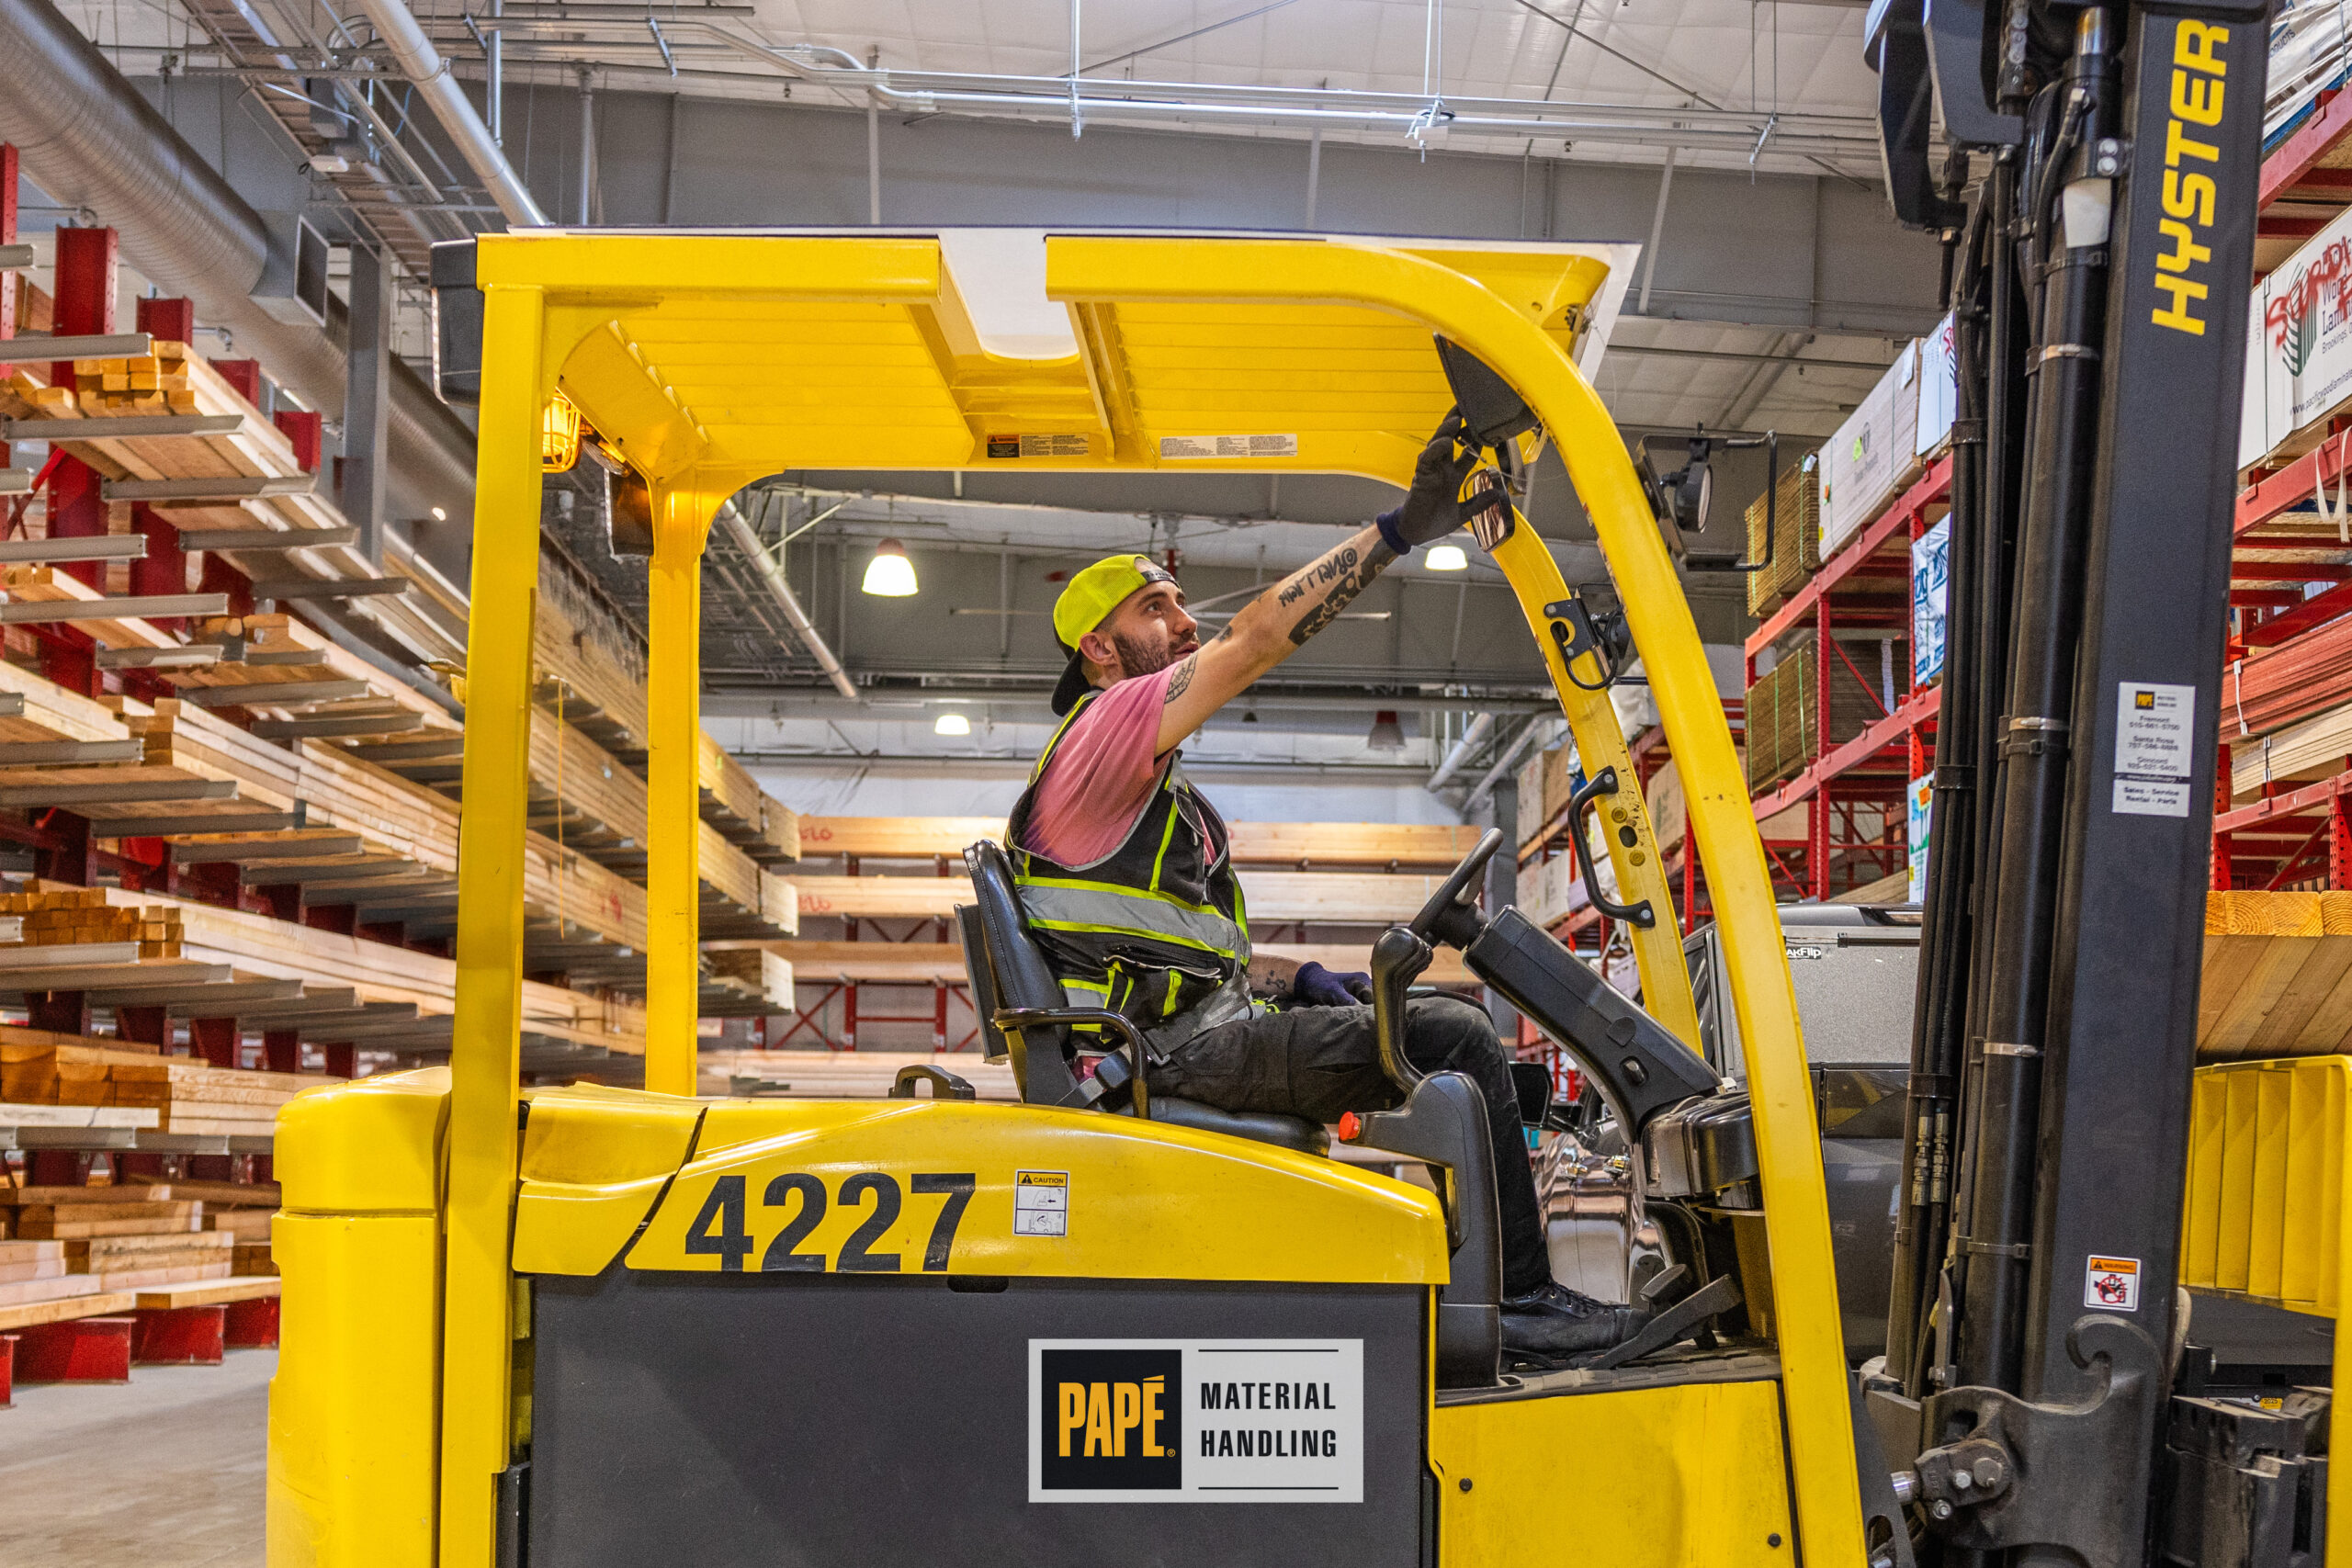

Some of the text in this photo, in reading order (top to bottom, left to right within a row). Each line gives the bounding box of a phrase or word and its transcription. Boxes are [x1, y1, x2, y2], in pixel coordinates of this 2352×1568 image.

[2152, 18, 2230, 336] HYSTER
[2152, 787, 2180, 796] Service
[1785, 947, 1822, 959] AKFlip
[685, 1172, 977, 1272] 4227
[1200, 1382, 1337, 1410] MATERIAL
[1200, 1429, 1337, 1458] HANDLING
